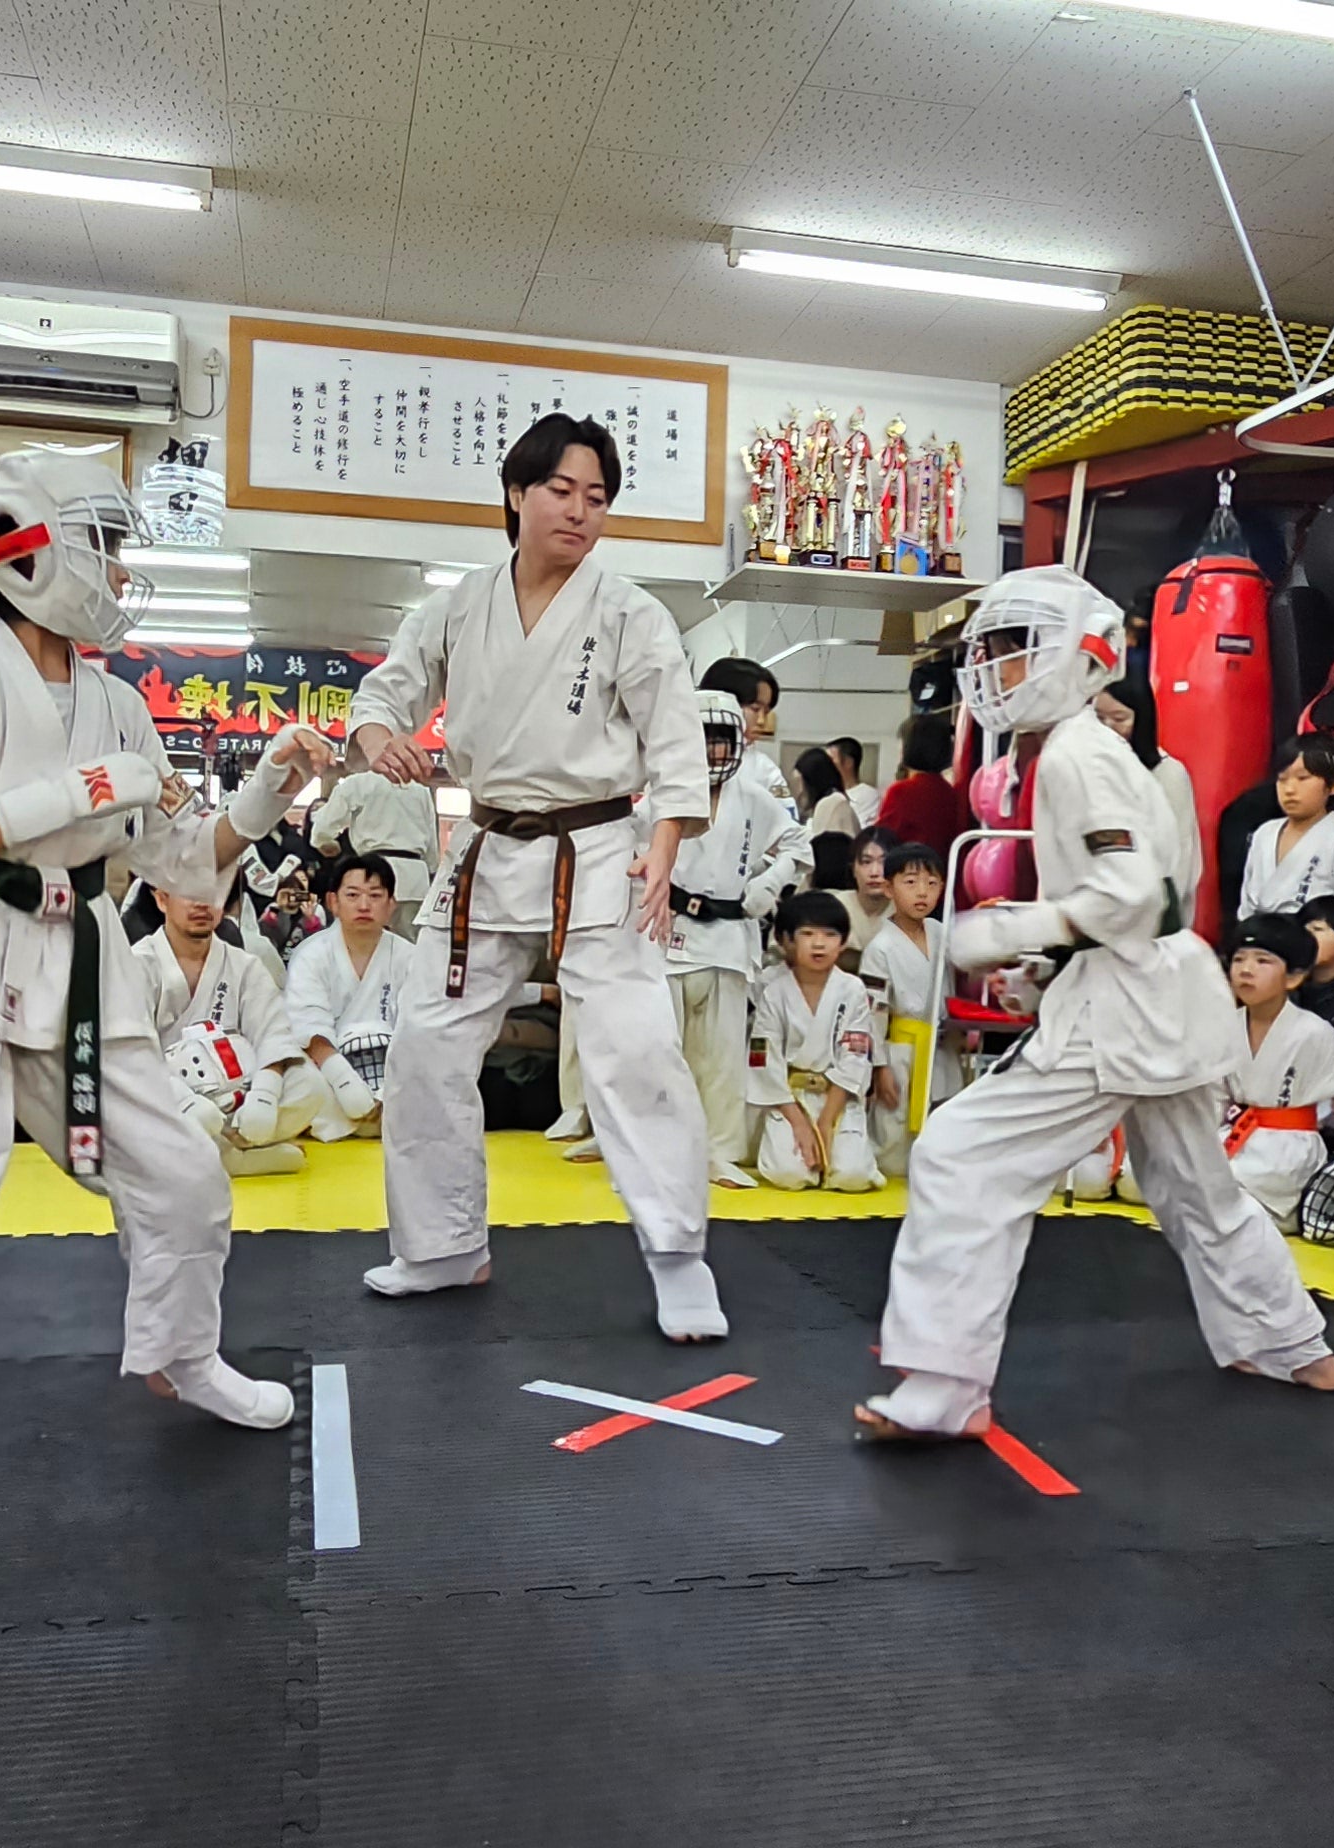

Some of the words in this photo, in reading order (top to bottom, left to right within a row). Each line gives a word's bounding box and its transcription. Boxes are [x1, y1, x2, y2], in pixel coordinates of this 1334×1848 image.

[291, 385, 305, 454] 極めること
[373, 393, 385, 447] すること
[394, 388, 408, 475] 仲間を大切に
[451, 400, 464, 467] させること
[472, 396, 487, 466] 人格を向上
[665, 408, 679, 461] 道場訓
